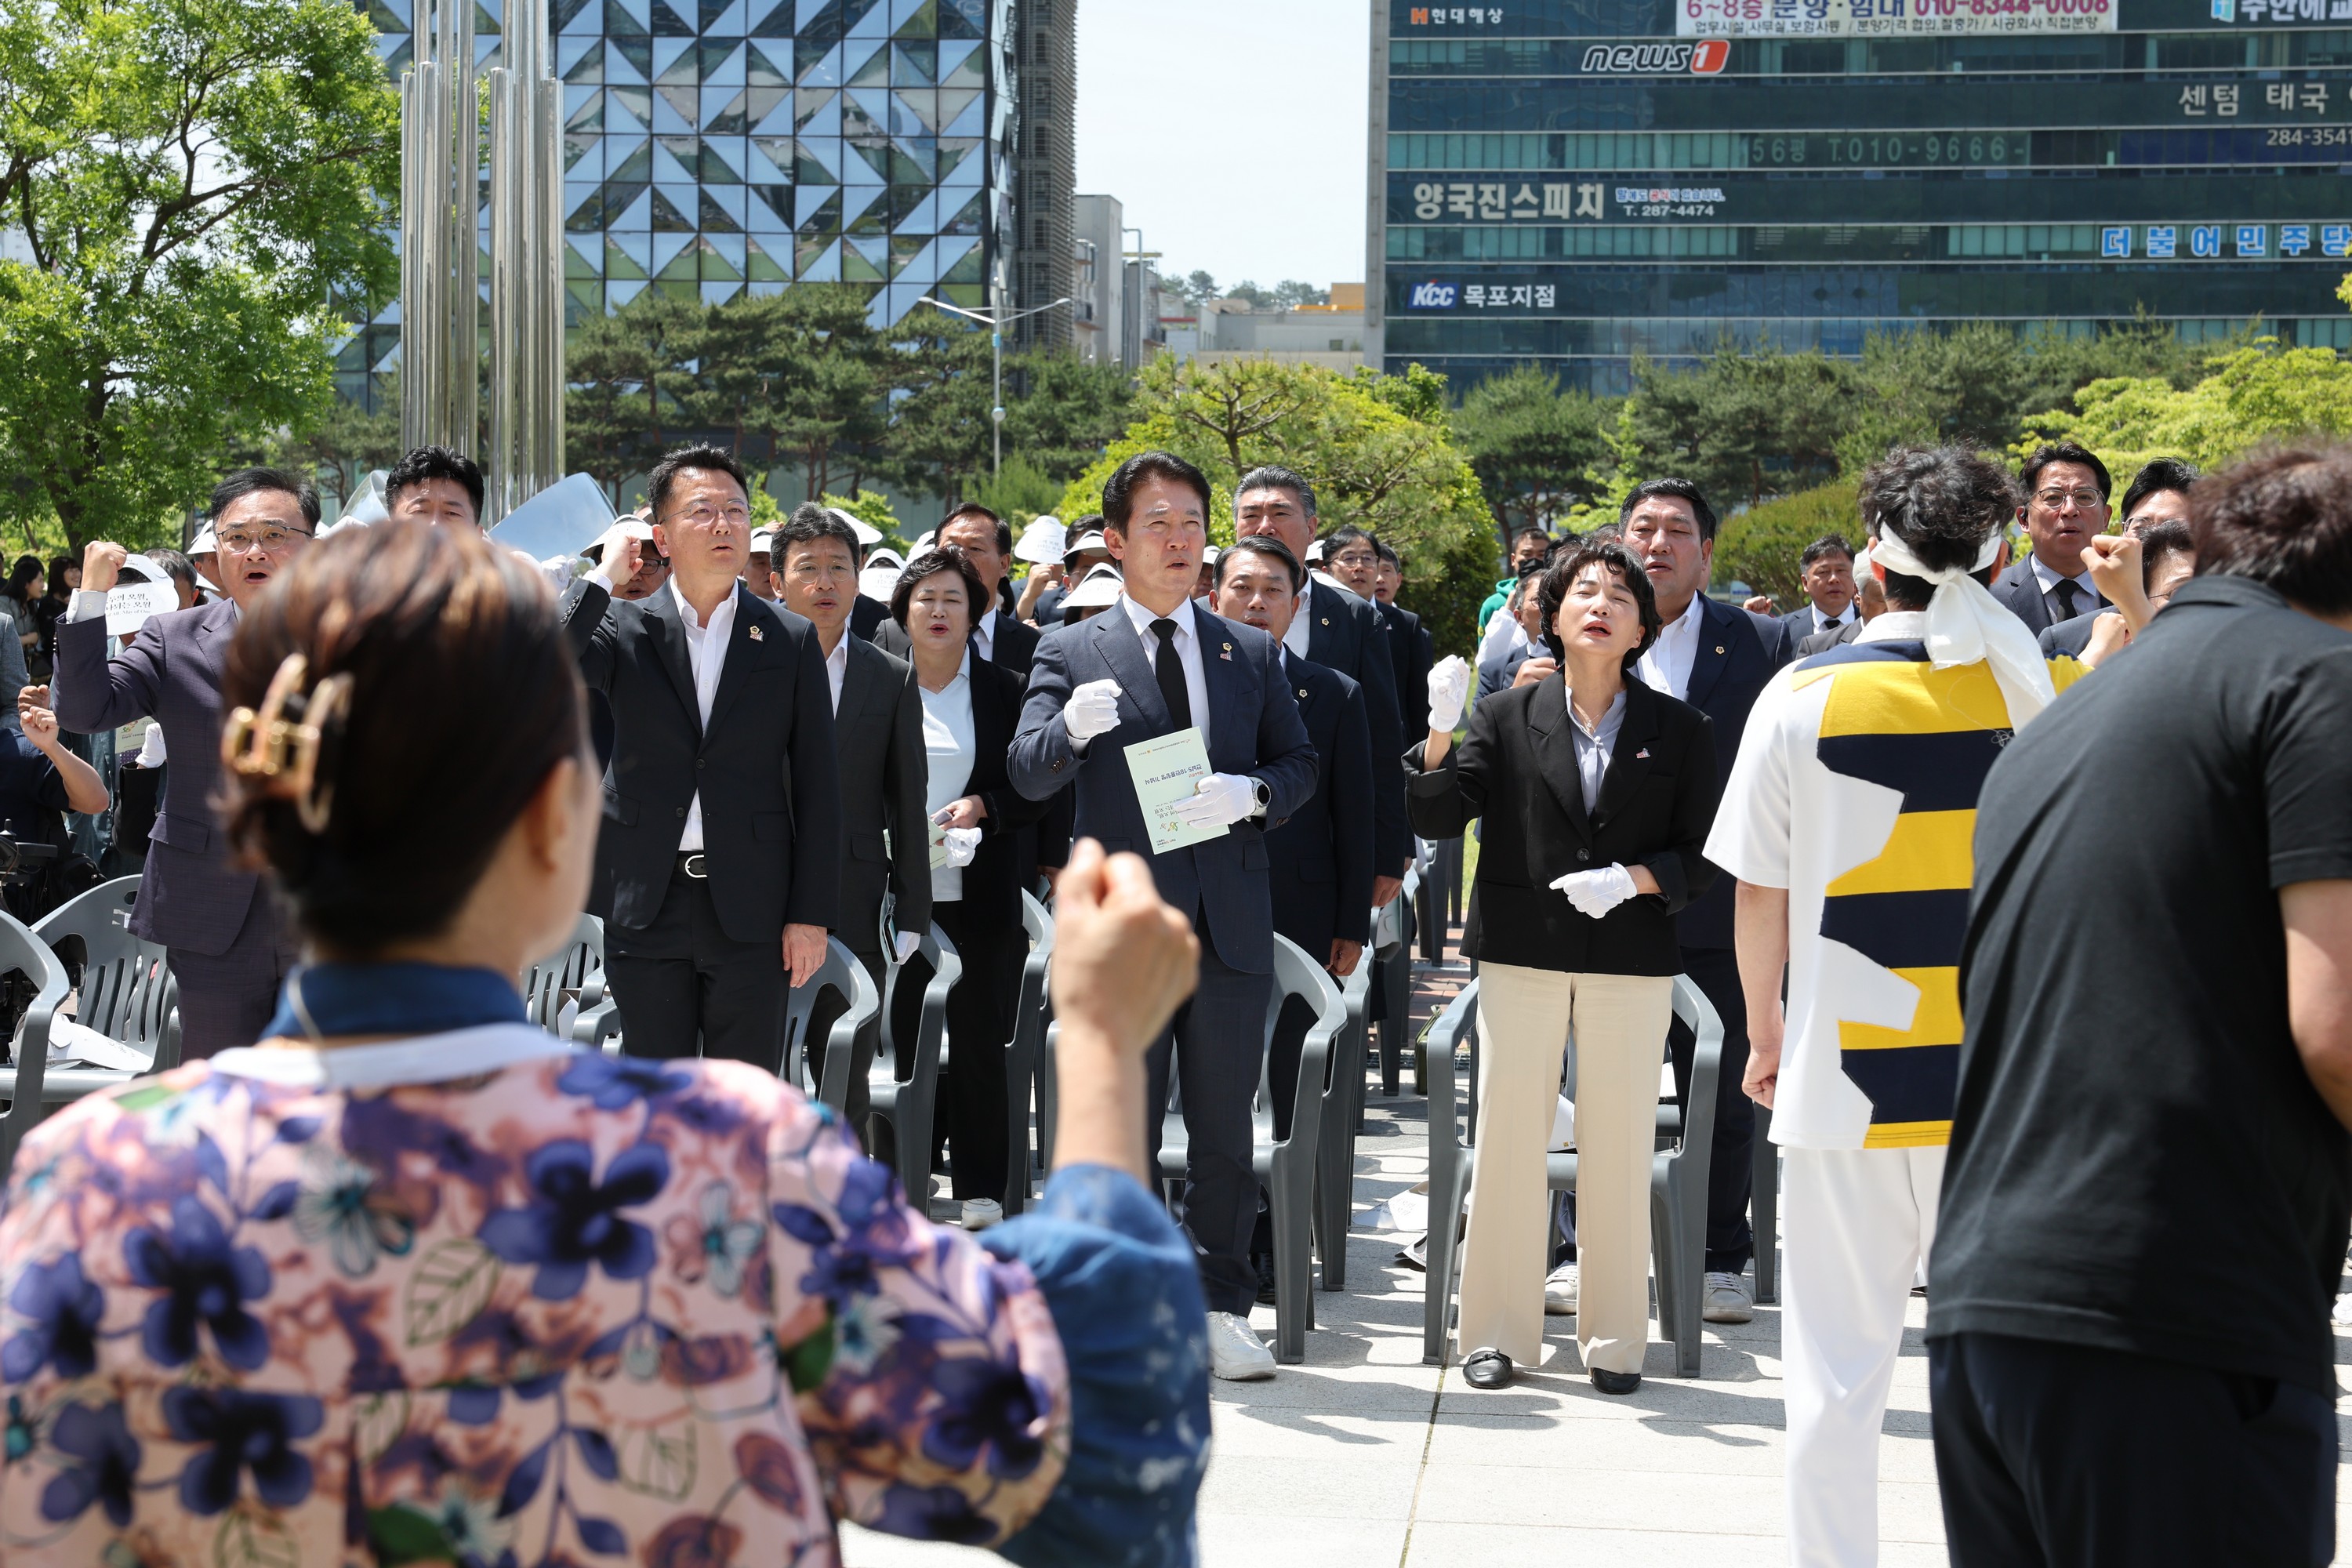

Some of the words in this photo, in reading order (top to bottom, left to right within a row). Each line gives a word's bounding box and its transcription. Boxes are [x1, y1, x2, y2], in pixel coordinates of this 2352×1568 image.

[1432, 8, 1504, 24] 현대해상
[1687, 0, 1763, 20] 6~8층
[1581, 40, 1730, 74] news1
[2178, 84, 2239, 116] 센텀
[2266, 83, 2330, 115] 태국
[1414, 183, 1605, 220] 양국진스피치
[1641, 205, 1715, 216] 287-4474
[2101, 225, 2352, 258] 더불어민주당
[1411, 278, 1456, 307] KCC
[1464, 284, 1556, 308] 목포지점
